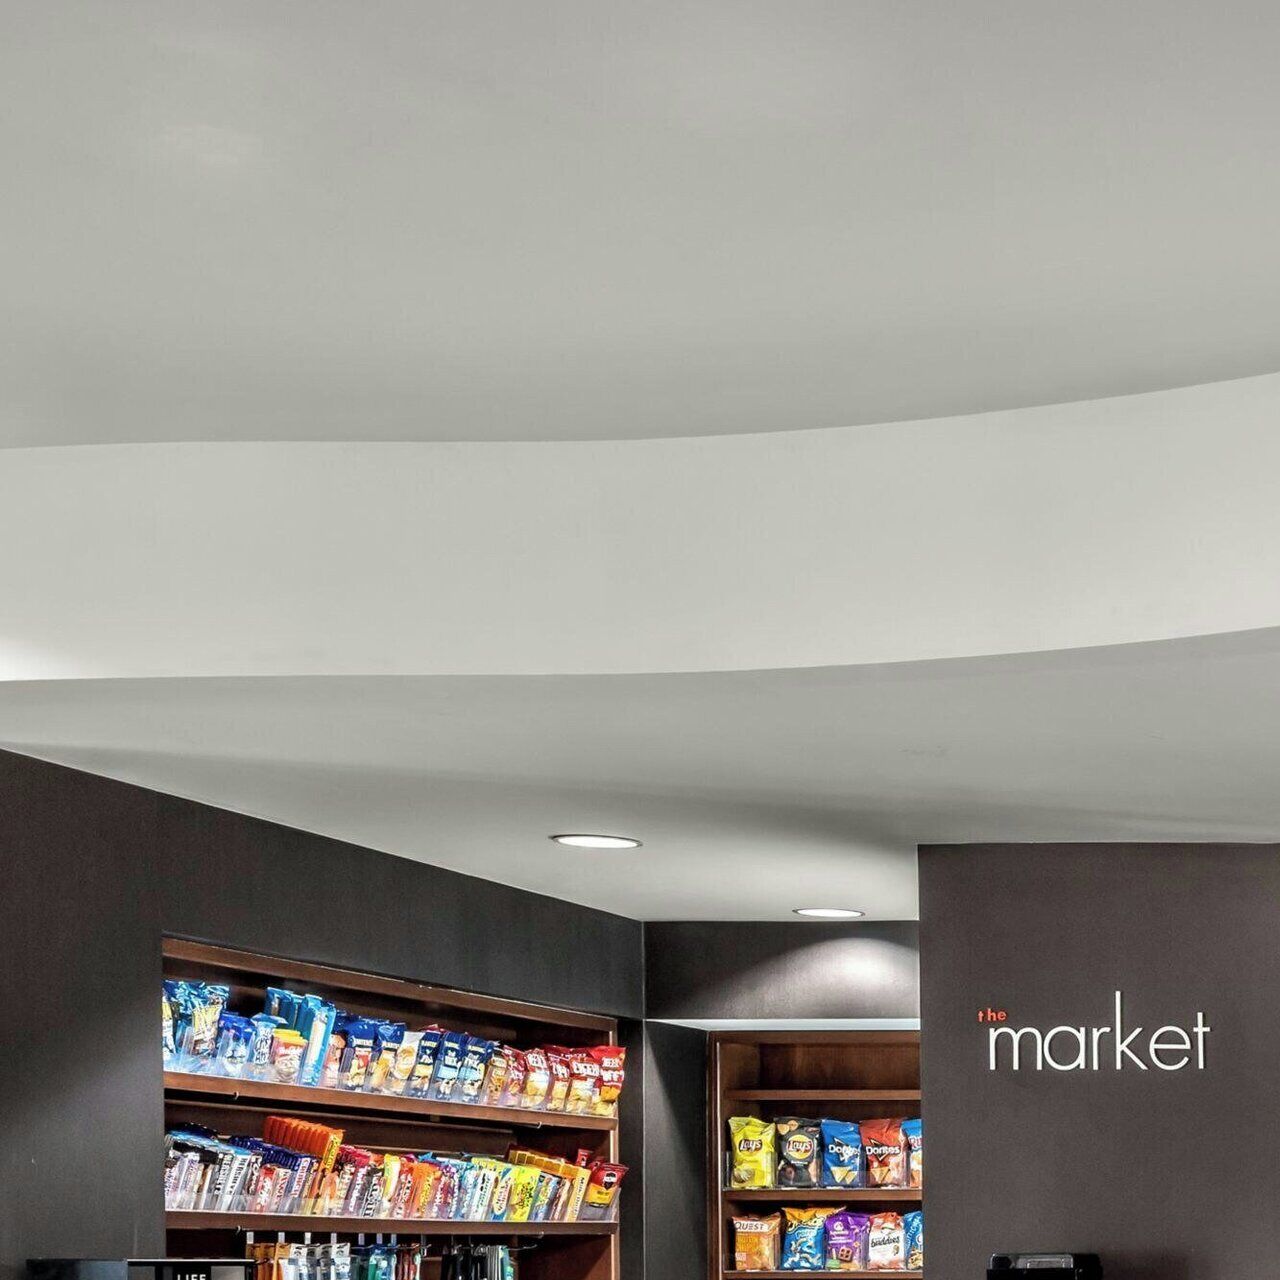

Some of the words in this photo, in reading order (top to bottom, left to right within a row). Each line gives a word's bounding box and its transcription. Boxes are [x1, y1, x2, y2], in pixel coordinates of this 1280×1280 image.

[978, 1008, 1007, 1022] the
[988, 990, 1211, 1071] market
[734, 1221, 764, 1231] QUEST
